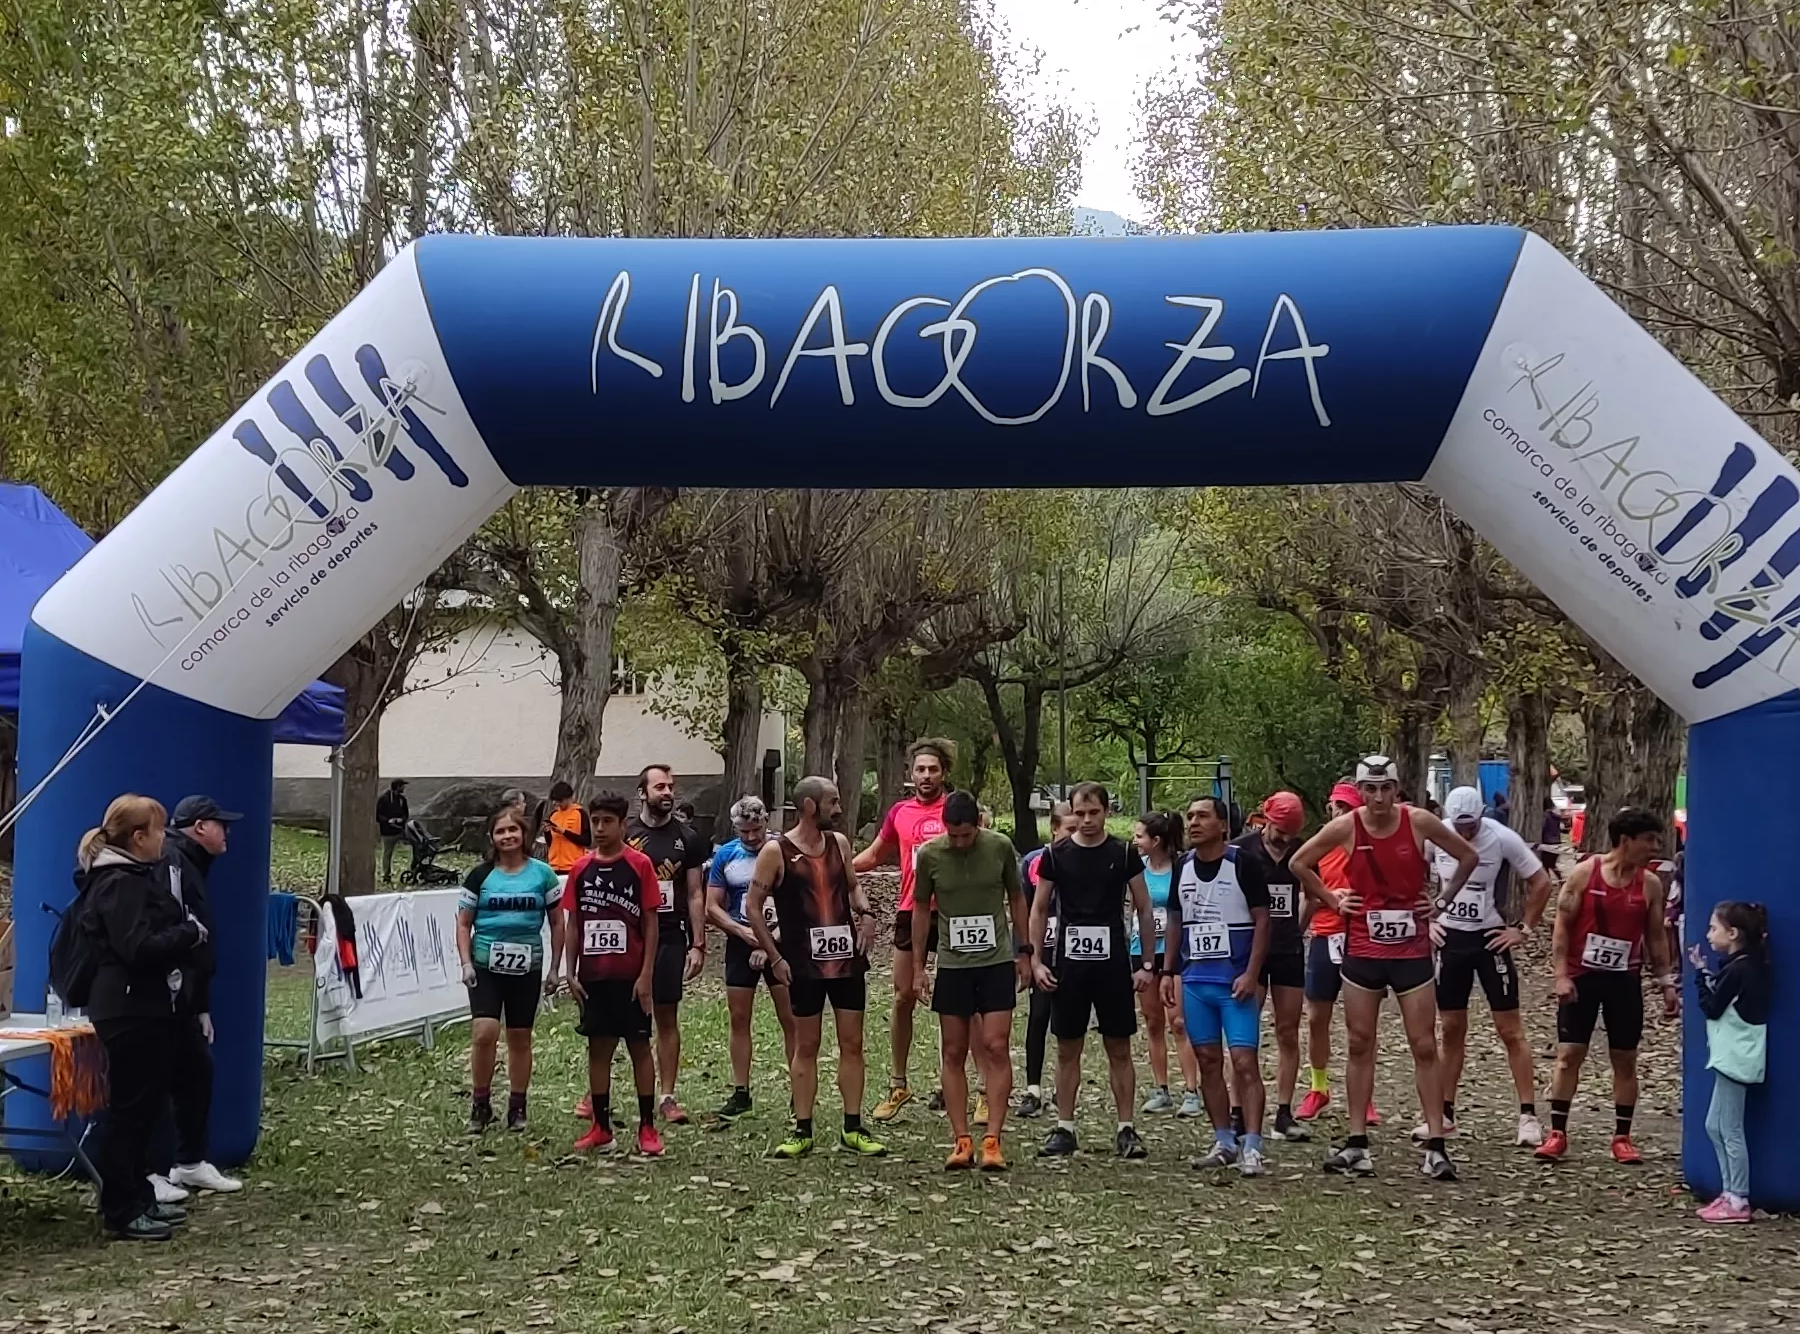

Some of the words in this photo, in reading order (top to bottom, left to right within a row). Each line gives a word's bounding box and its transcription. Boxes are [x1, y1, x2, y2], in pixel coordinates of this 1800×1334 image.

[592, 268, 1332, 427] RIBAGORZA
[1483, 408, 1555, 478] comarca
[1554, 477, 1577, 500] de
[1576, 495, 1597, 517] la
[1594, 515, 1671, 586] ribagza
[130, 377, 447, 650] RIBAGORZA
[1532, 490, 1580, 535] servicio
[1579, 535, 1598, 552] de
[1598, 552, 1653, 603] deportes
[265, 585, 310, 628] servicio
[309, 569, 328, 586] de
[327, 522, 379, 570] deportes
[180, 607, 252, 671] comarca
[250, 586, 273, 608] de
[268, 570, 291, 588] la
[288, 506, 360, 573] ribagza
[1448, 901, 1479, 918] 286
[956, 928, 989, 945] 152
[1373, 921, 1409, 938] 257
[816, 936, 849, 954] 268
[1070, 937, 1105, 954] 294
[1194, 935, 1222, 952] 187
[493, 952, 526, 969] 272
[1592, 948, 1623, 966] 157
